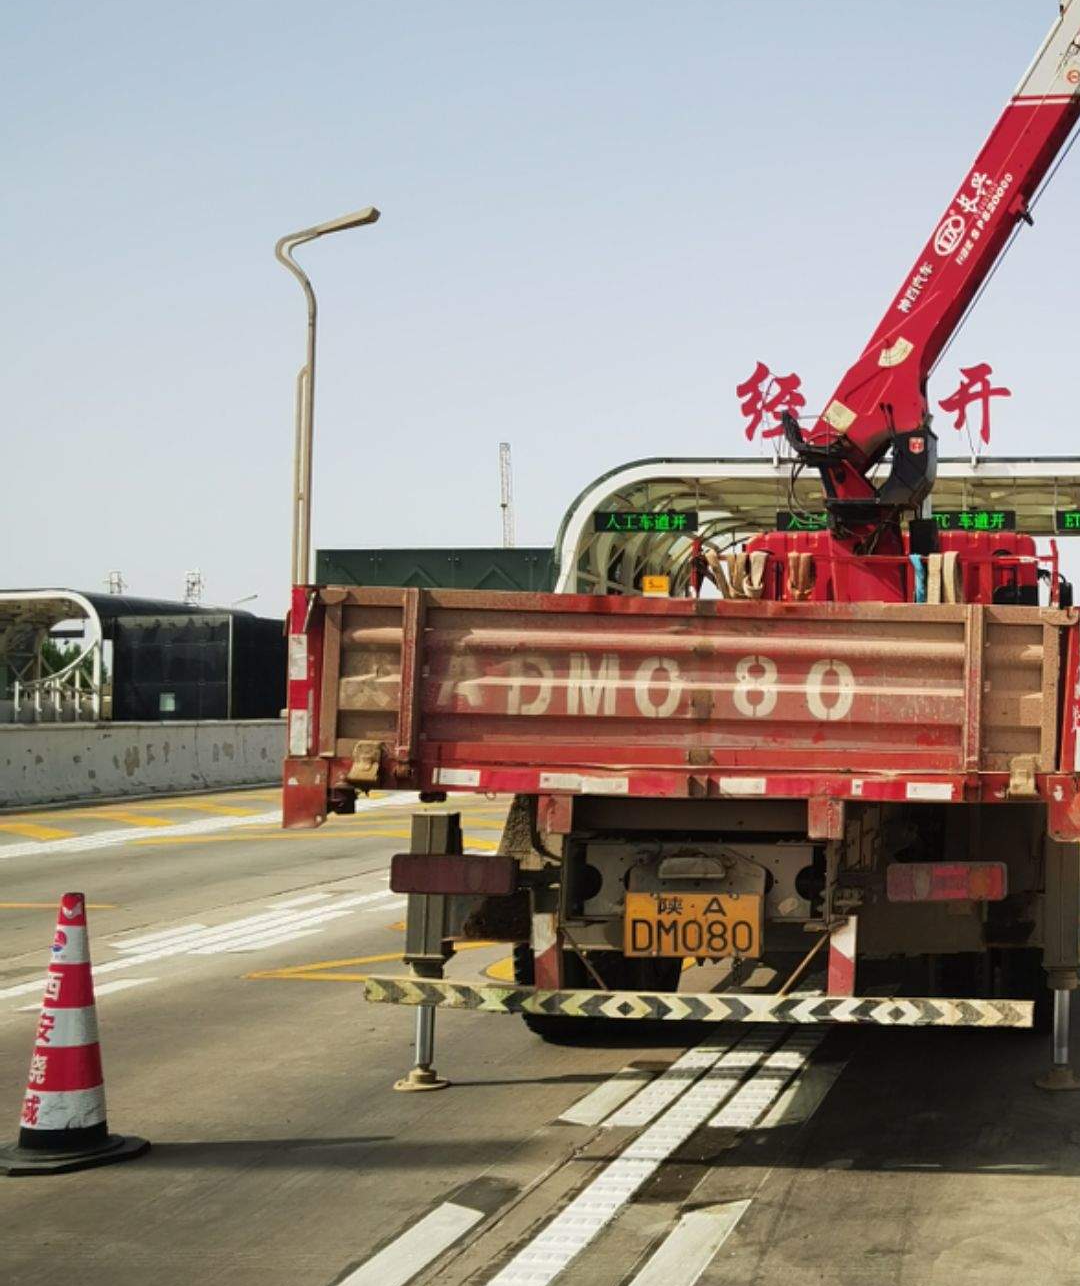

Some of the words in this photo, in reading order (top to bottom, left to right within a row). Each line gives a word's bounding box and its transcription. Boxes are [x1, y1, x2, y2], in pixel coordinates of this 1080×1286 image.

[606, 514, 687, 530] 人工车道开
[632, 919, 753, 953] DM080
